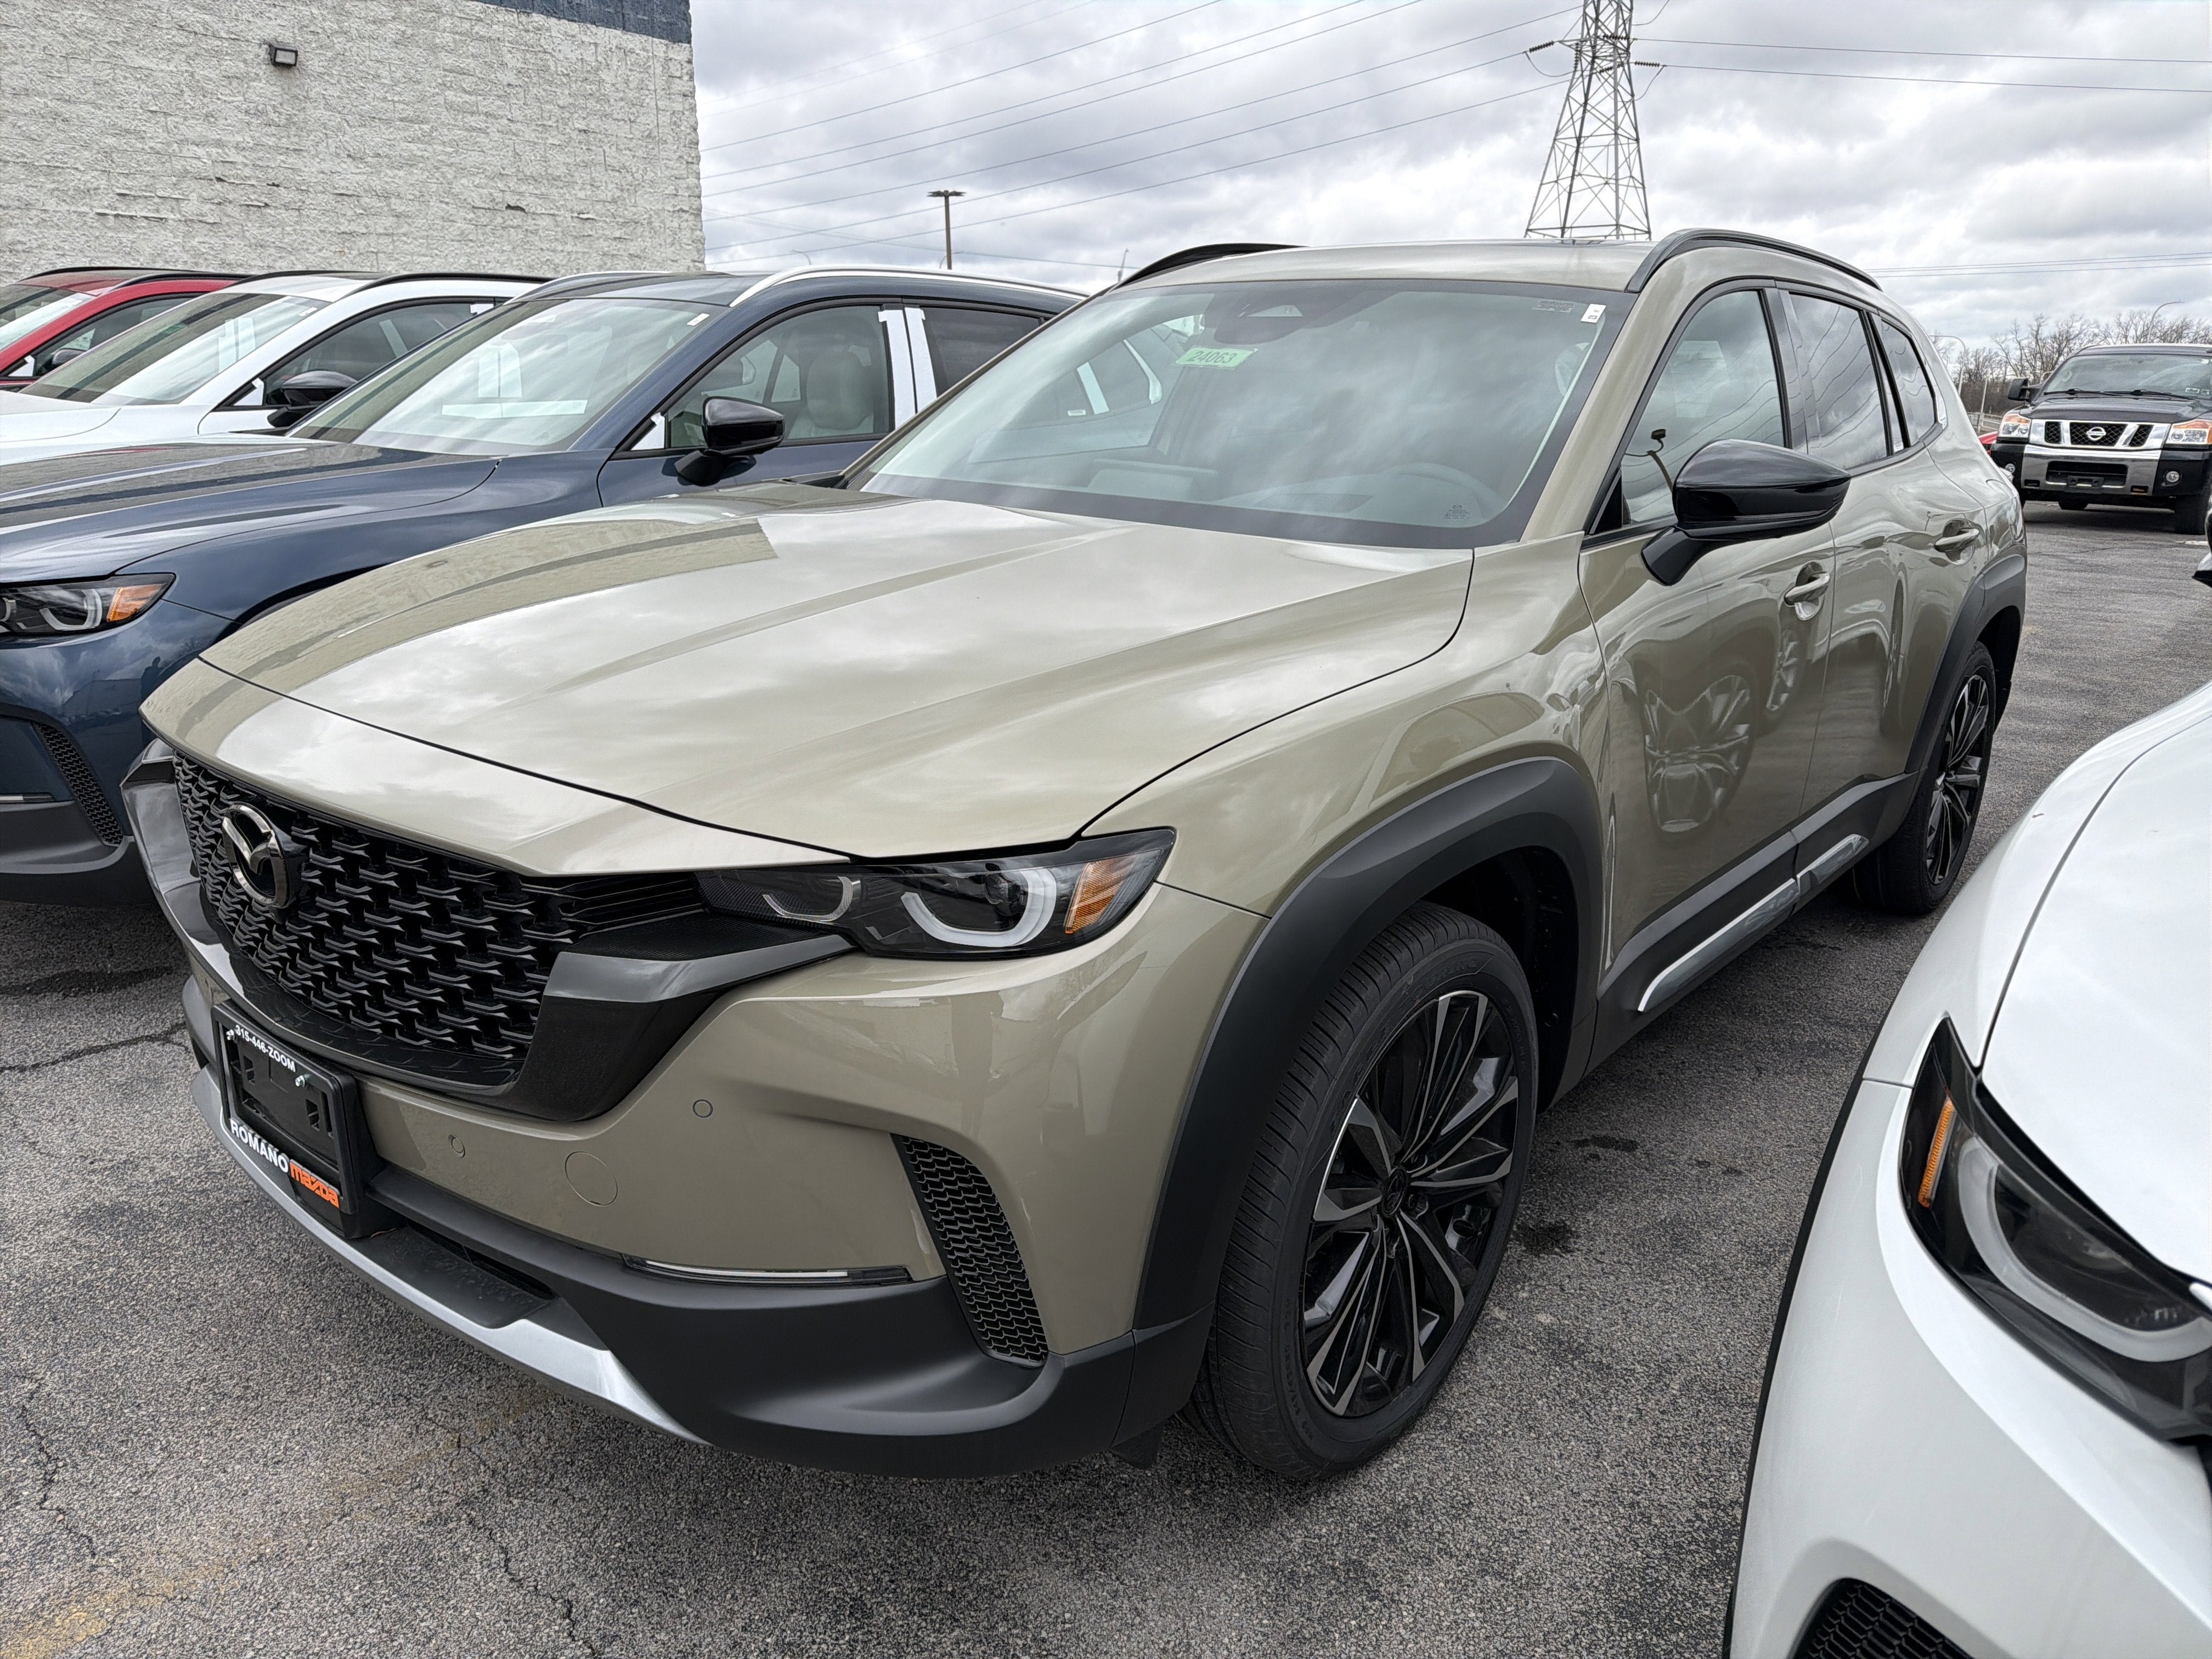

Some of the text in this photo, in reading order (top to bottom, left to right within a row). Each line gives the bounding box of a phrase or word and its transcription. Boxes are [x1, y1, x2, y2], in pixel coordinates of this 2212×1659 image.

[1187, 351, 1238, 364] 24063
[235, 1024, 296, 1073] 315-446-ZOOM
[230, 1118, 289, 1173] ROMANO
